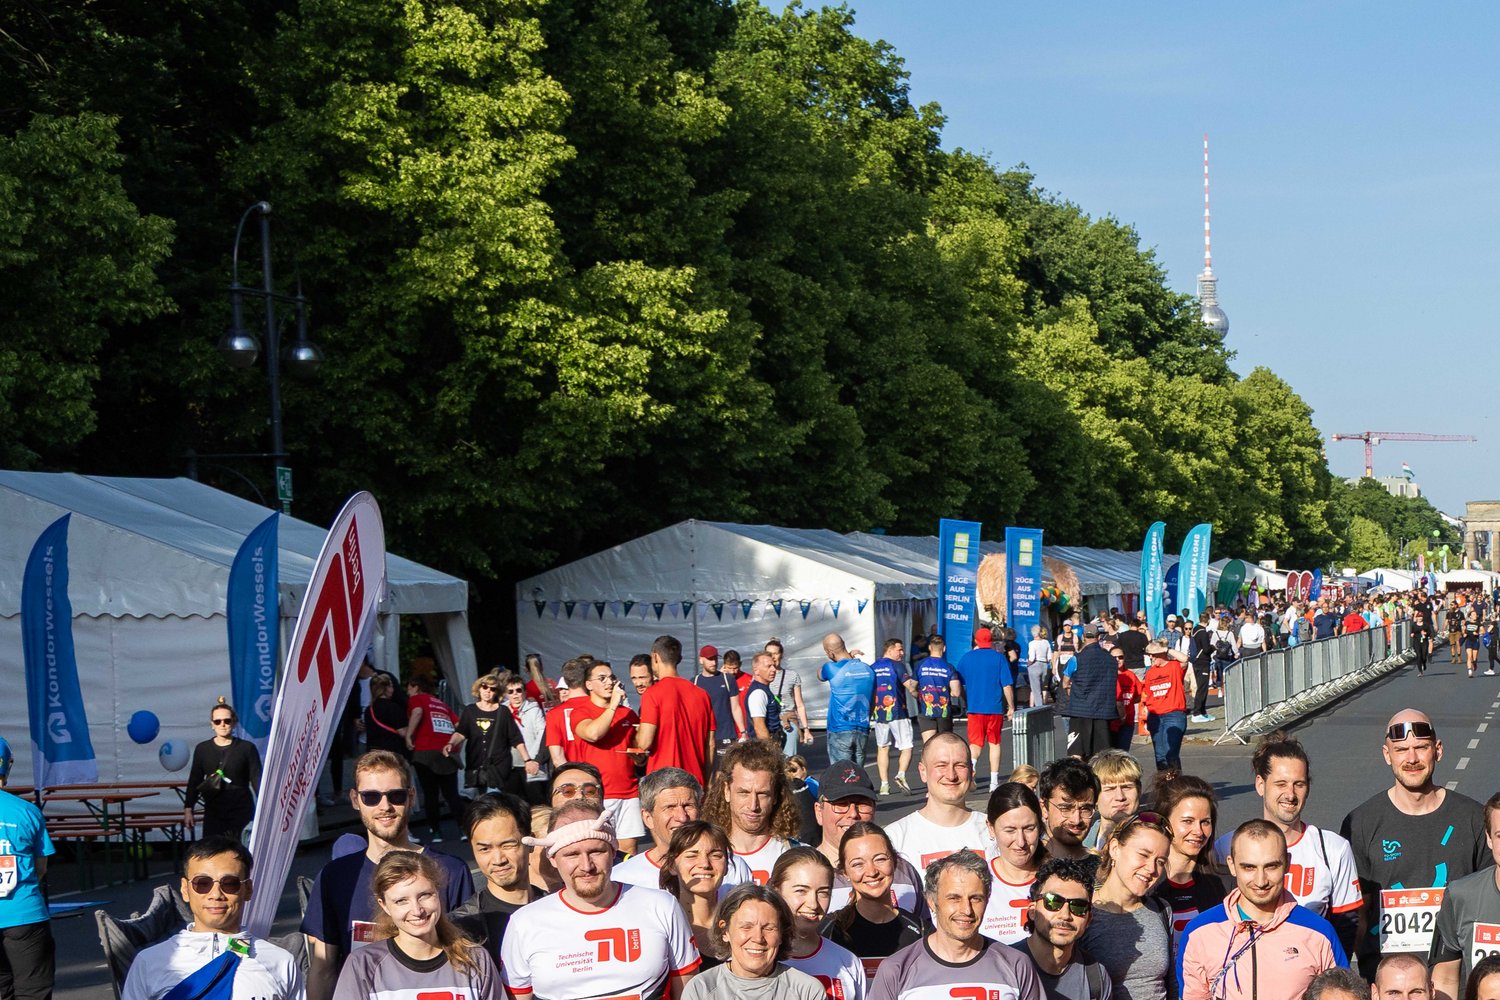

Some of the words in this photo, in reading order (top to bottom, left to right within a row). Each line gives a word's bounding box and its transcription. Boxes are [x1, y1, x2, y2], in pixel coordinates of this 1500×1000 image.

[348, 526, 360, 594] berlin
[43, 545, 62, 707] KondorWessels
[251, 546, 273, 691] KondorWessels
[984, 922, 1016, 930] Universität
[987, 915, 1017, 923] Technische
[1382, 911, 1436, 935] 2042
[632, 930, 640, 950] berlin
[558, 950, 594, 960] Technische
[555, 958, 594, 968] Universität
[572, 965, 593, 973] Berlin
